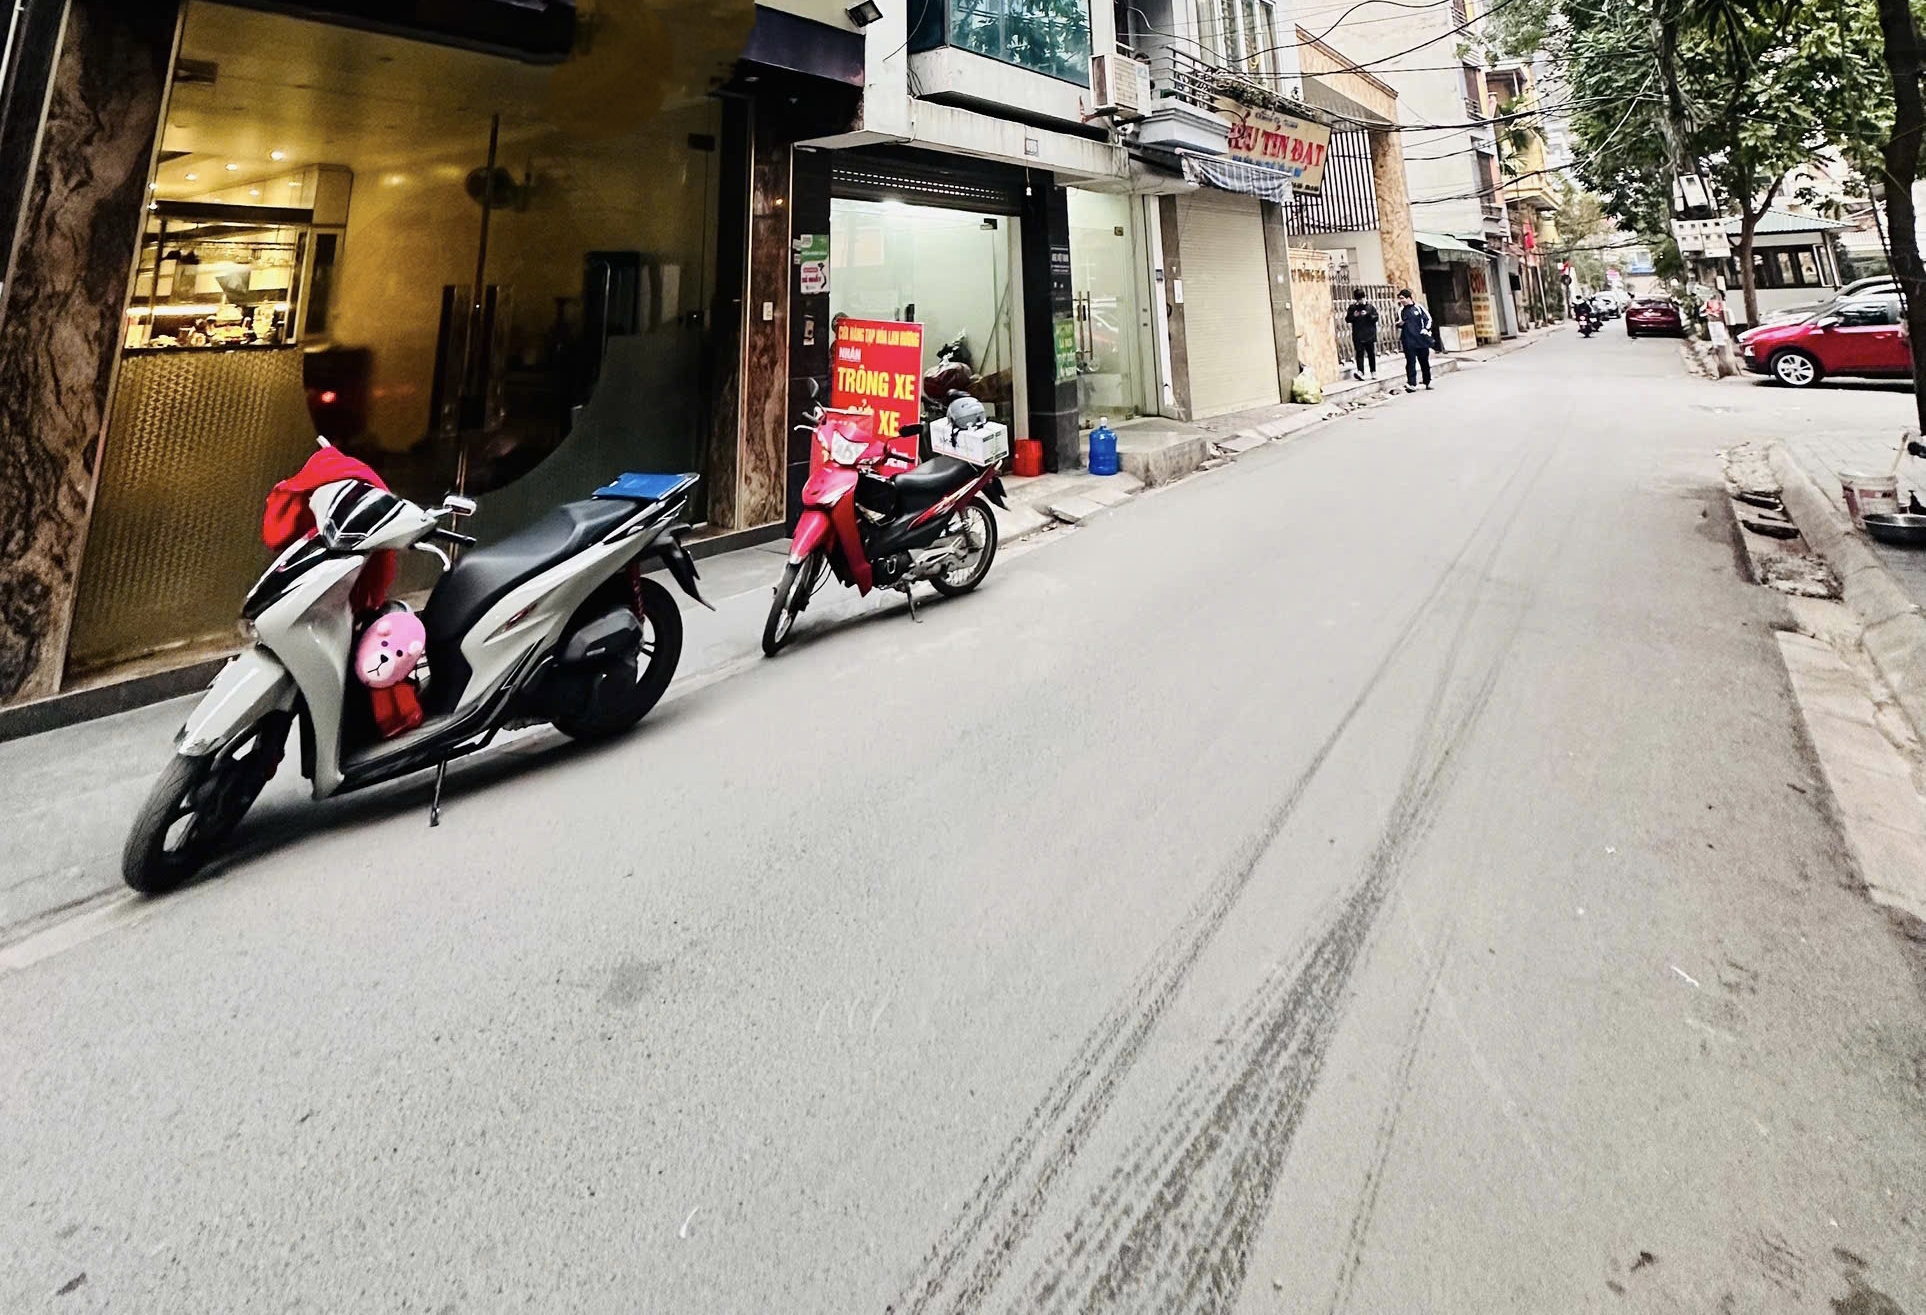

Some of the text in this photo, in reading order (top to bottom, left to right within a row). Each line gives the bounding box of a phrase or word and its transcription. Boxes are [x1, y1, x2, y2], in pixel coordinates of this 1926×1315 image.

[1291, 138, 1325, 171] ĐẠT
[838, 364, 915, 400] TRÔNG XE
[878, 409, 900, 437] XE
